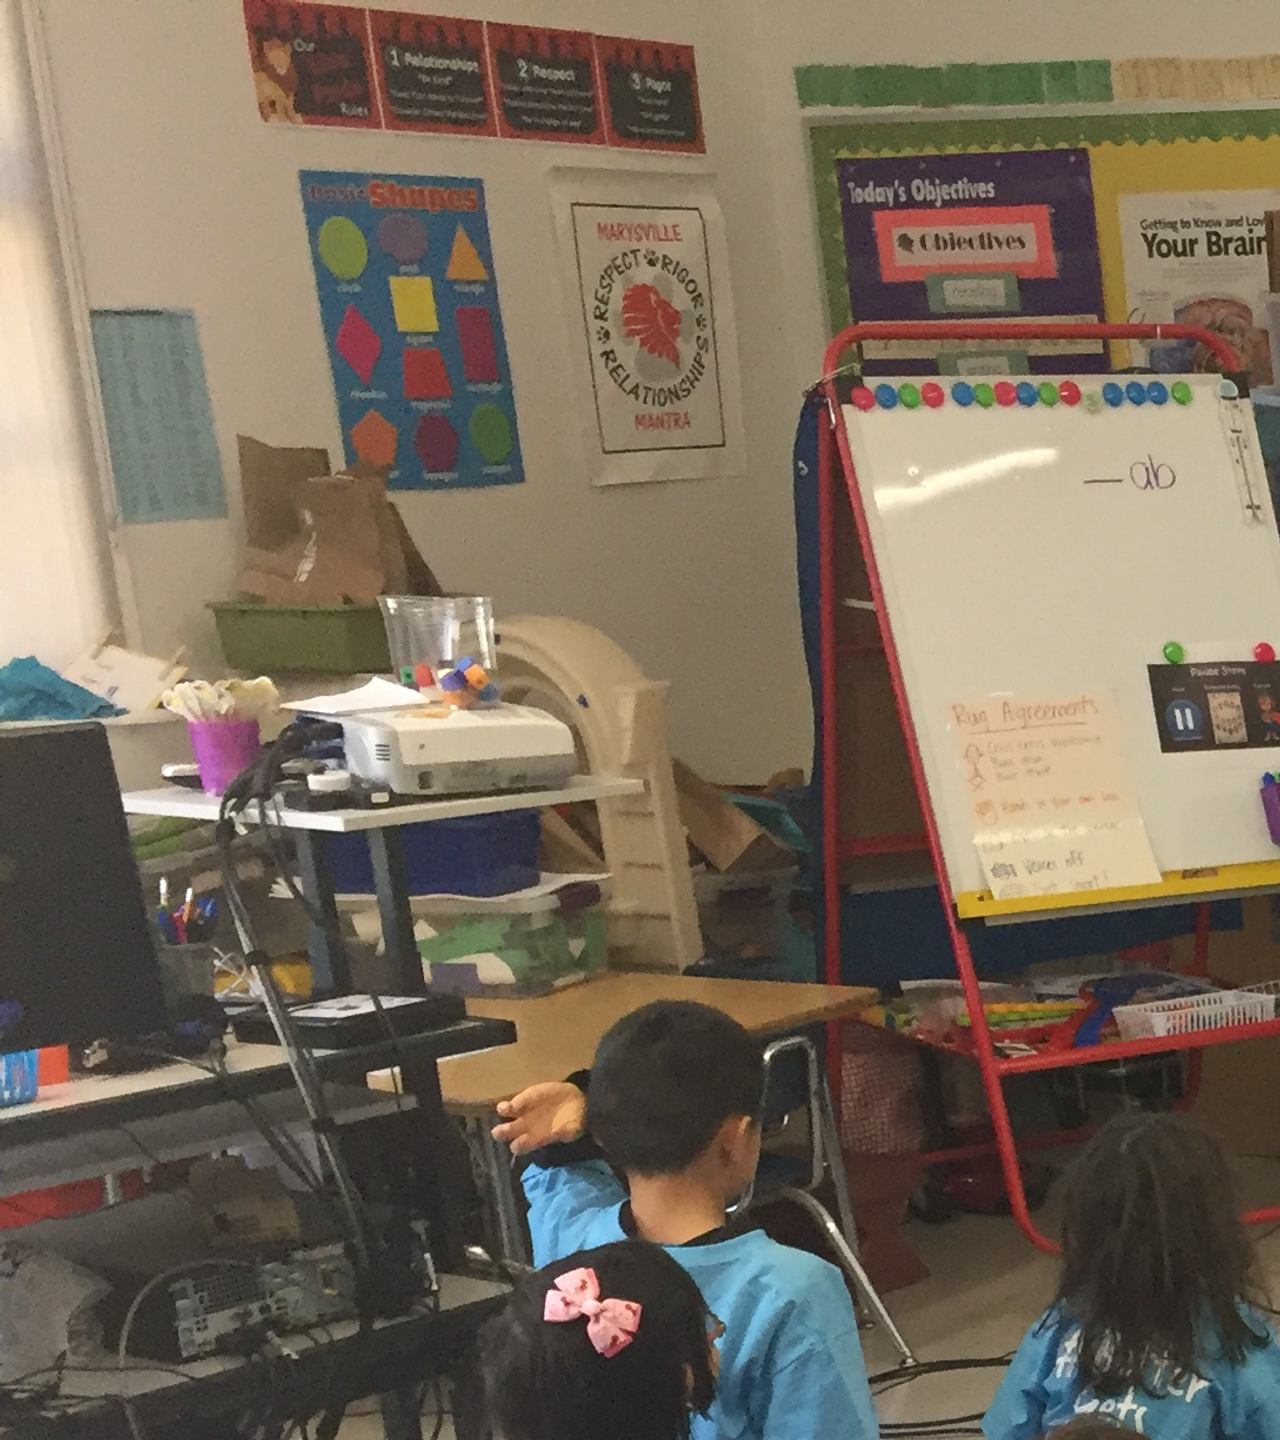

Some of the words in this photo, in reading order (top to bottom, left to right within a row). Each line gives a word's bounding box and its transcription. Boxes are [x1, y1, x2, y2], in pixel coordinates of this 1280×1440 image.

[404, 51, 479, 73] Relationships
[518, 58, 529, 80] 2
[532, 65, 576, 83] Respect
[631, 71, 643, 91] 3
[367, 180, 481, 213] Shapes
[847, 179, 906, 207] Today's
[910, 177, 996, 207] Objectives
[597, 221, 683, 243] MARYSVILLE
[1140, 217, 1178, 234] Getting
[1180, 217, 1192, 230] to
[1193, 217, 1223, 229] Know
[1225, 215, 1245, 228] and
[1246, 215, 1265, 227] Lov
[919, 232, 1027, 251] Objectives
[1141, 231, 1196, 259] Your
[593, 249, 641, 323] RESPECT
[660, 253, 705, 310] RIGOR
[600, 336, 709, 408] RELATIONSHIPS
[634, 411, 691, 432] MANTRA
[1001, 695, 1099, 730] Agreements
